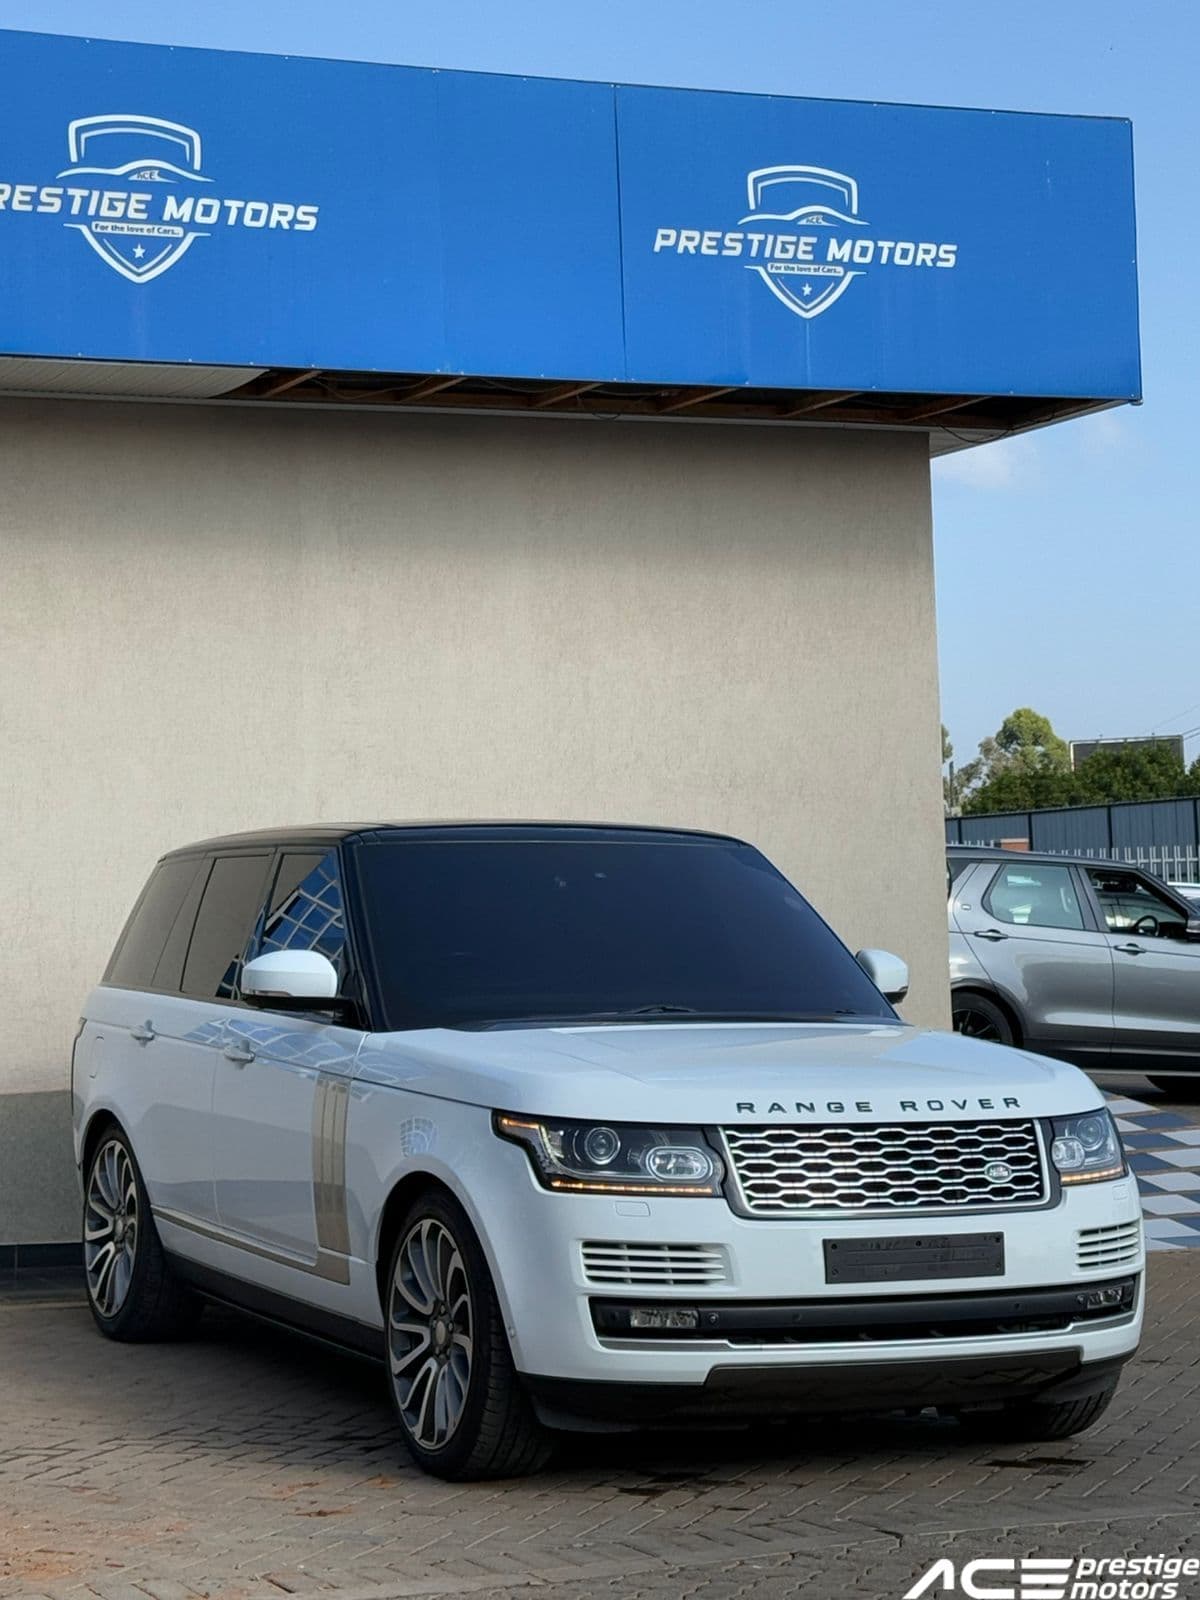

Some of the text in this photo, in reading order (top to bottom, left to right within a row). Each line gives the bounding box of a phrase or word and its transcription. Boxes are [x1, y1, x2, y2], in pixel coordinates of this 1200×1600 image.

[162, 195, 320, 231] MOTORS
[94, 223, 109, 231] For
[110, 224, 126, 233] the
[126, 225, 146, 234] love
[146, 226, 156, 234] of
[653, 228, 958, 268] PRESTIGE MOTORS
[769, 263, 783, 271] For
[783, 264, 796, 272] the
[796, 264, 812, 273] love
[812, 265, 822, 273] of
[736, 1097, 1022, 1114] RANGE ROVER
